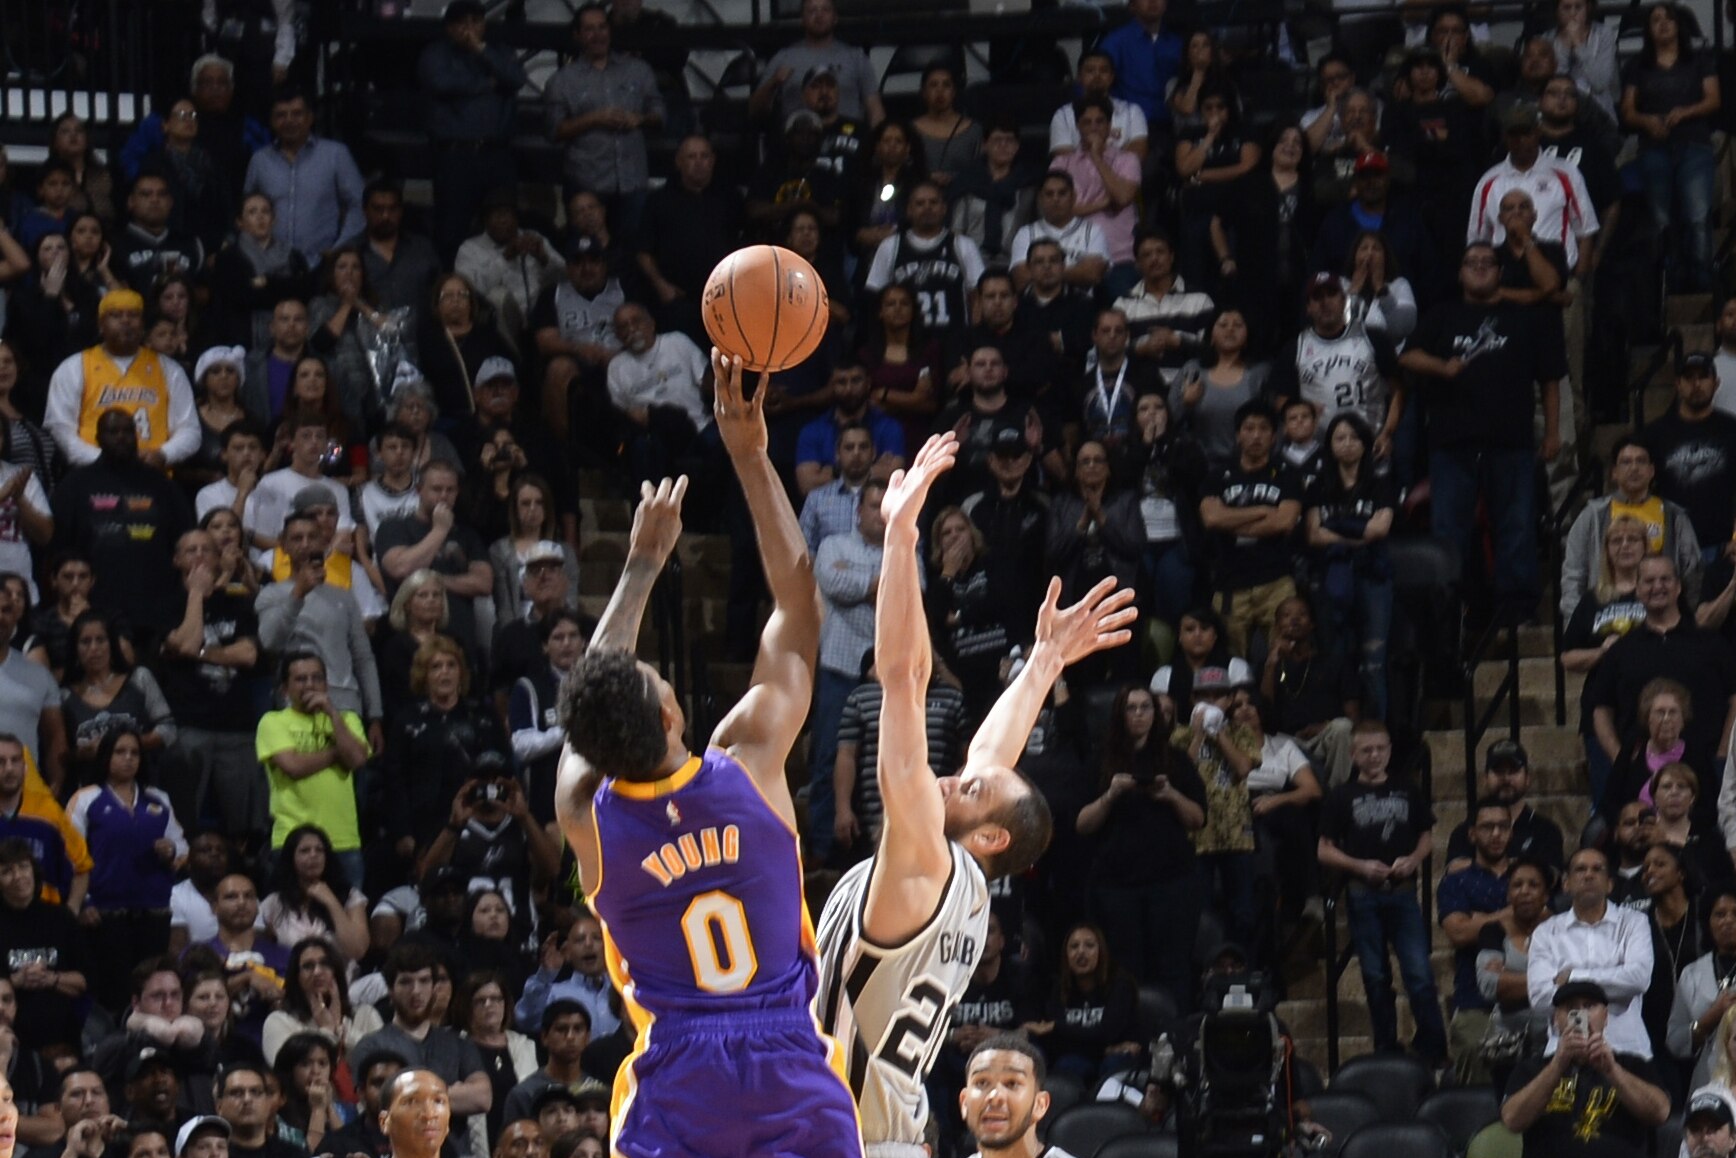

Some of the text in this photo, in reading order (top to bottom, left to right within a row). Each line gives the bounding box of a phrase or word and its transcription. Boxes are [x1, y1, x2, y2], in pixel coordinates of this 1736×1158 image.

[97, 384, 168, 409] LAKERS
[1334, 380, 1368, 409] 21
[640, 824, 741, 888] YOUNG
[680, 889, 759, 993] 0
